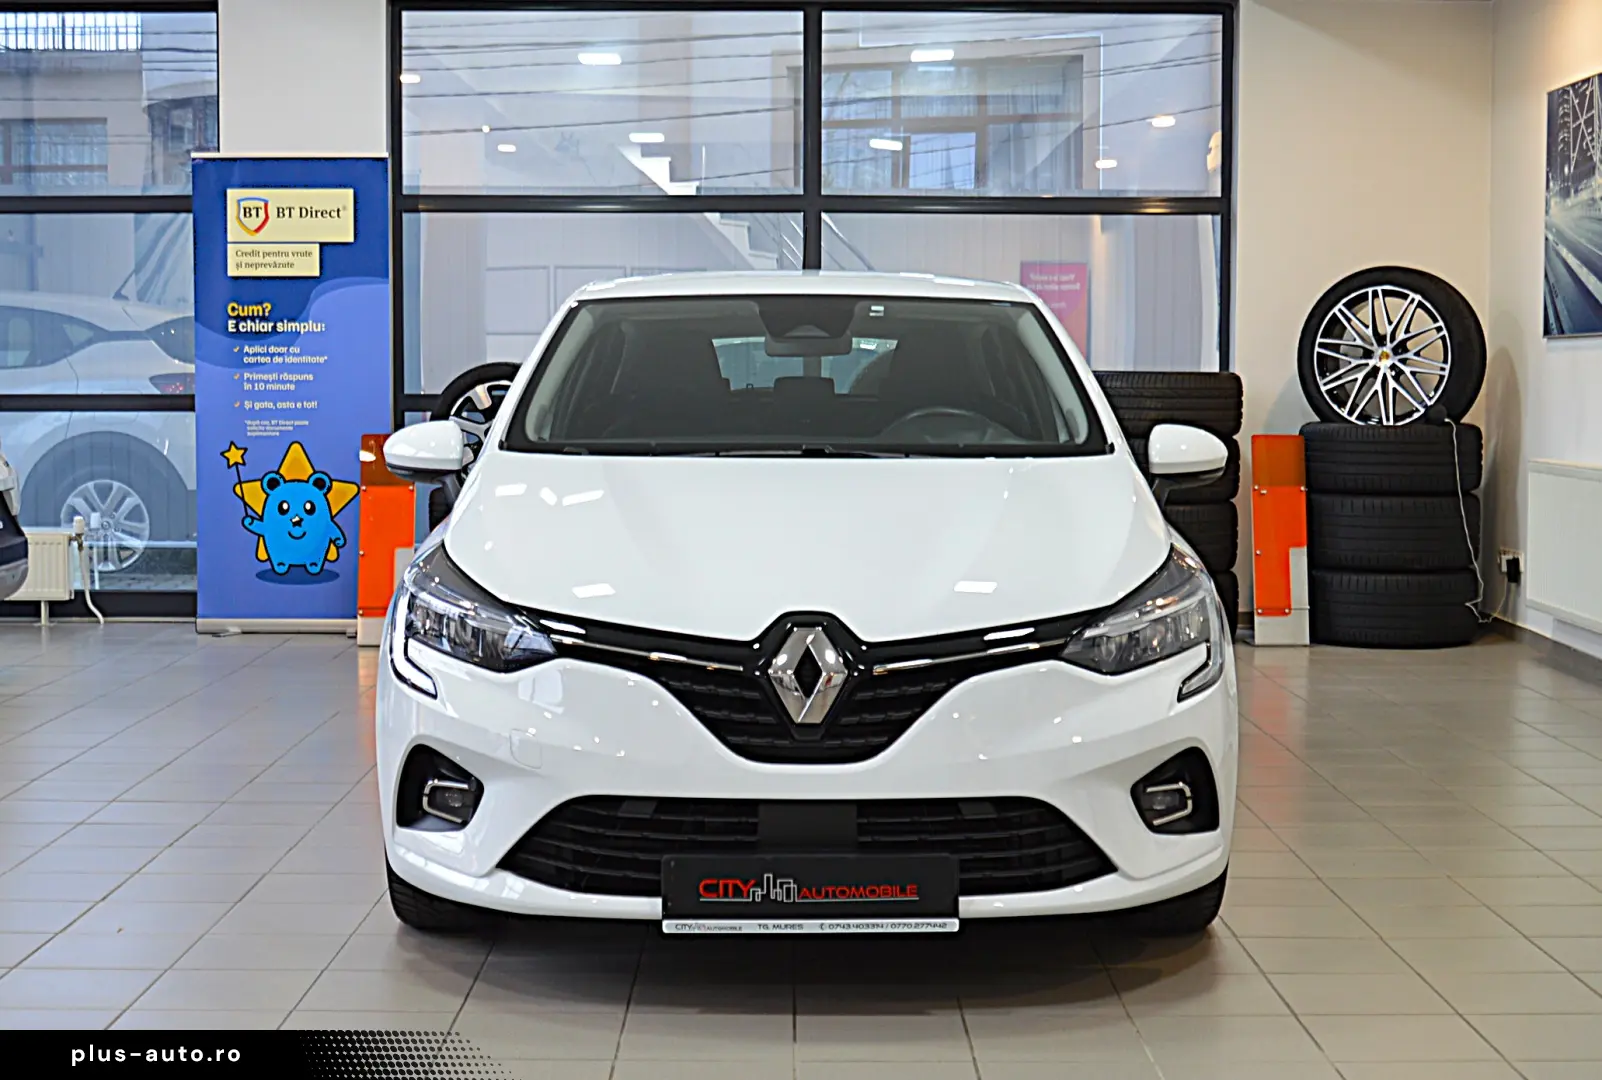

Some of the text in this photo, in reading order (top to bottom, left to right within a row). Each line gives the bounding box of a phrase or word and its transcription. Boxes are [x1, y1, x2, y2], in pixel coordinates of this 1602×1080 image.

[243, 207, 262, 218] BT
[276, 206, 341, 219] BT Direct
[262, 250, 289, 259] pentru
[244, 262, 295, 270] neprevăzute
[227, 302, 272, 316] Cum?
[228, 320, 326, 334] E chiar simplu:
[244, 346, 267, 355] Aplici
[268, 346, 288, 354] doar
[244, 372, 314, 382] Primești răspuns
[244, 382, 252, 390] în
[266, 382, 296, 390] minute
[254, 401, 276, 410] gata,
[303, 400, 318, 408] tot!
[700, 879, 918, 899] CITY AUTOMOBILE
